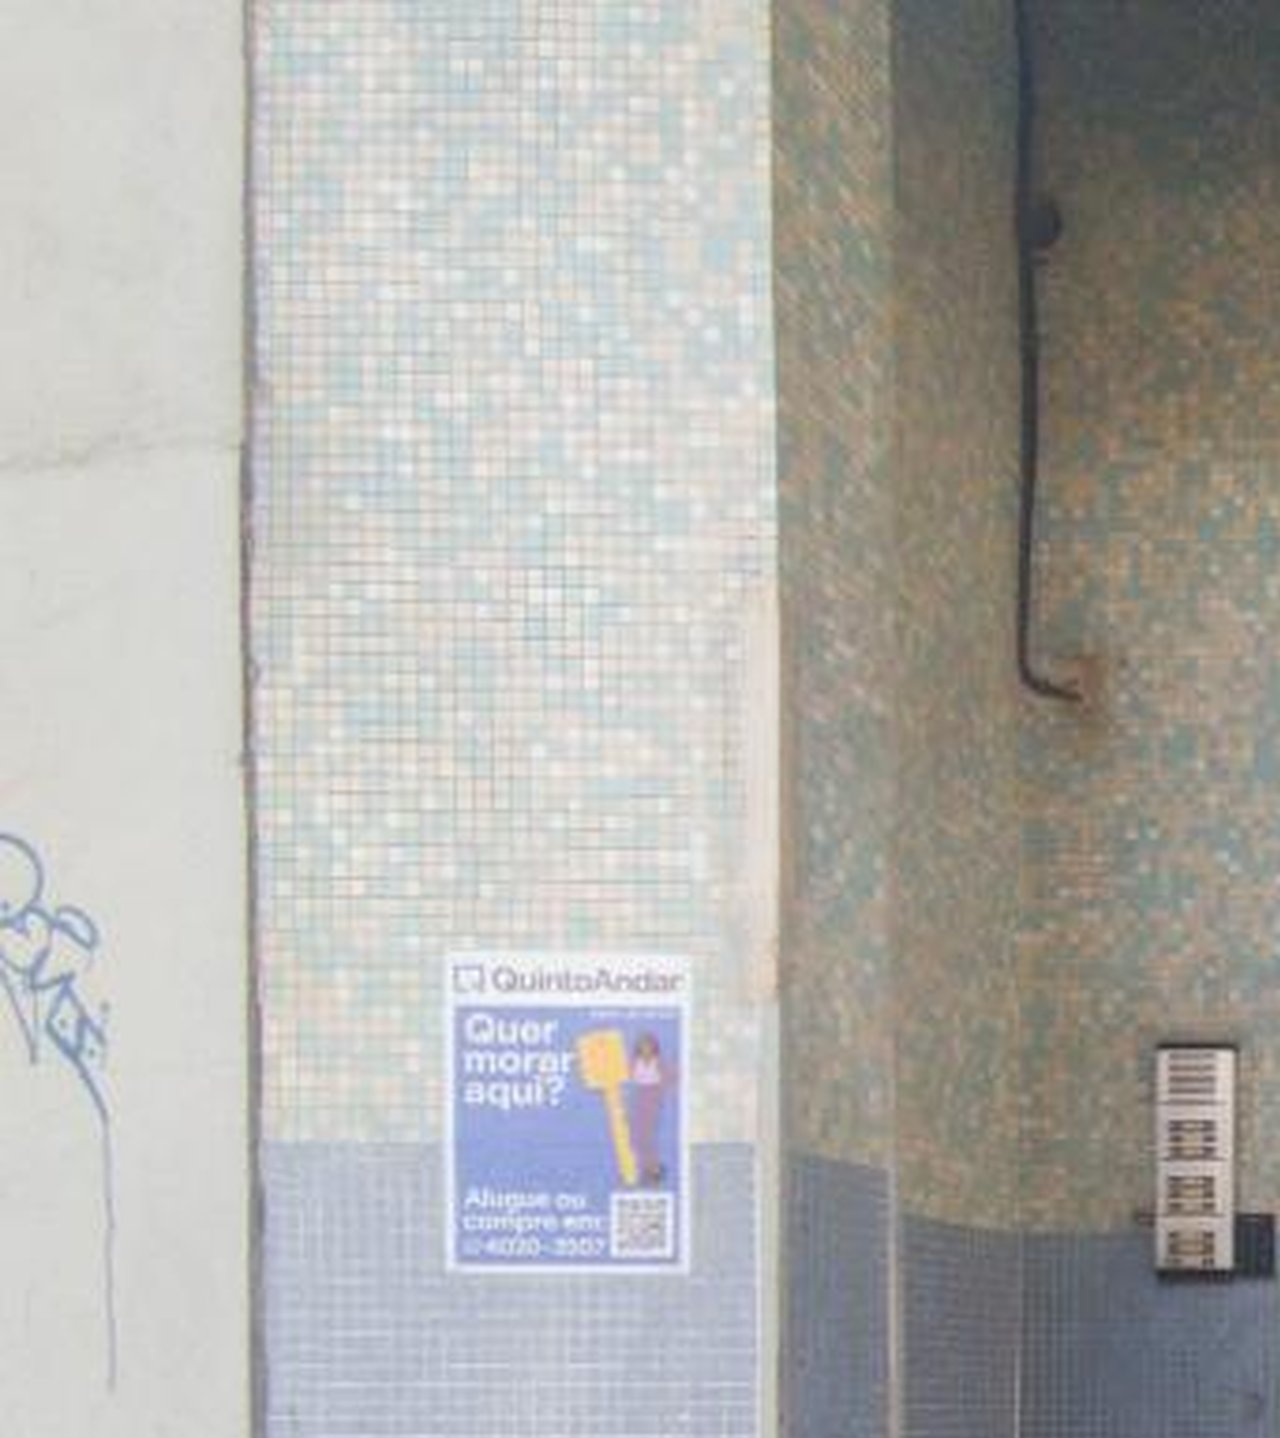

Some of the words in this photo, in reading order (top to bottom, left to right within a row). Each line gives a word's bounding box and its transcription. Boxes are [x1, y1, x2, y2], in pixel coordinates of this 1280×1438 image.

[491, 966, 684, 993] QuintoAndar
[465, 1013, 559, 1045] Quer
[465, 1049, 573, 1074] morar
[464, 1074, 566, 1110] aqui?
[463, 1188, 550, 1214] Alugue
[556, 1193, 586, 1211] ou
